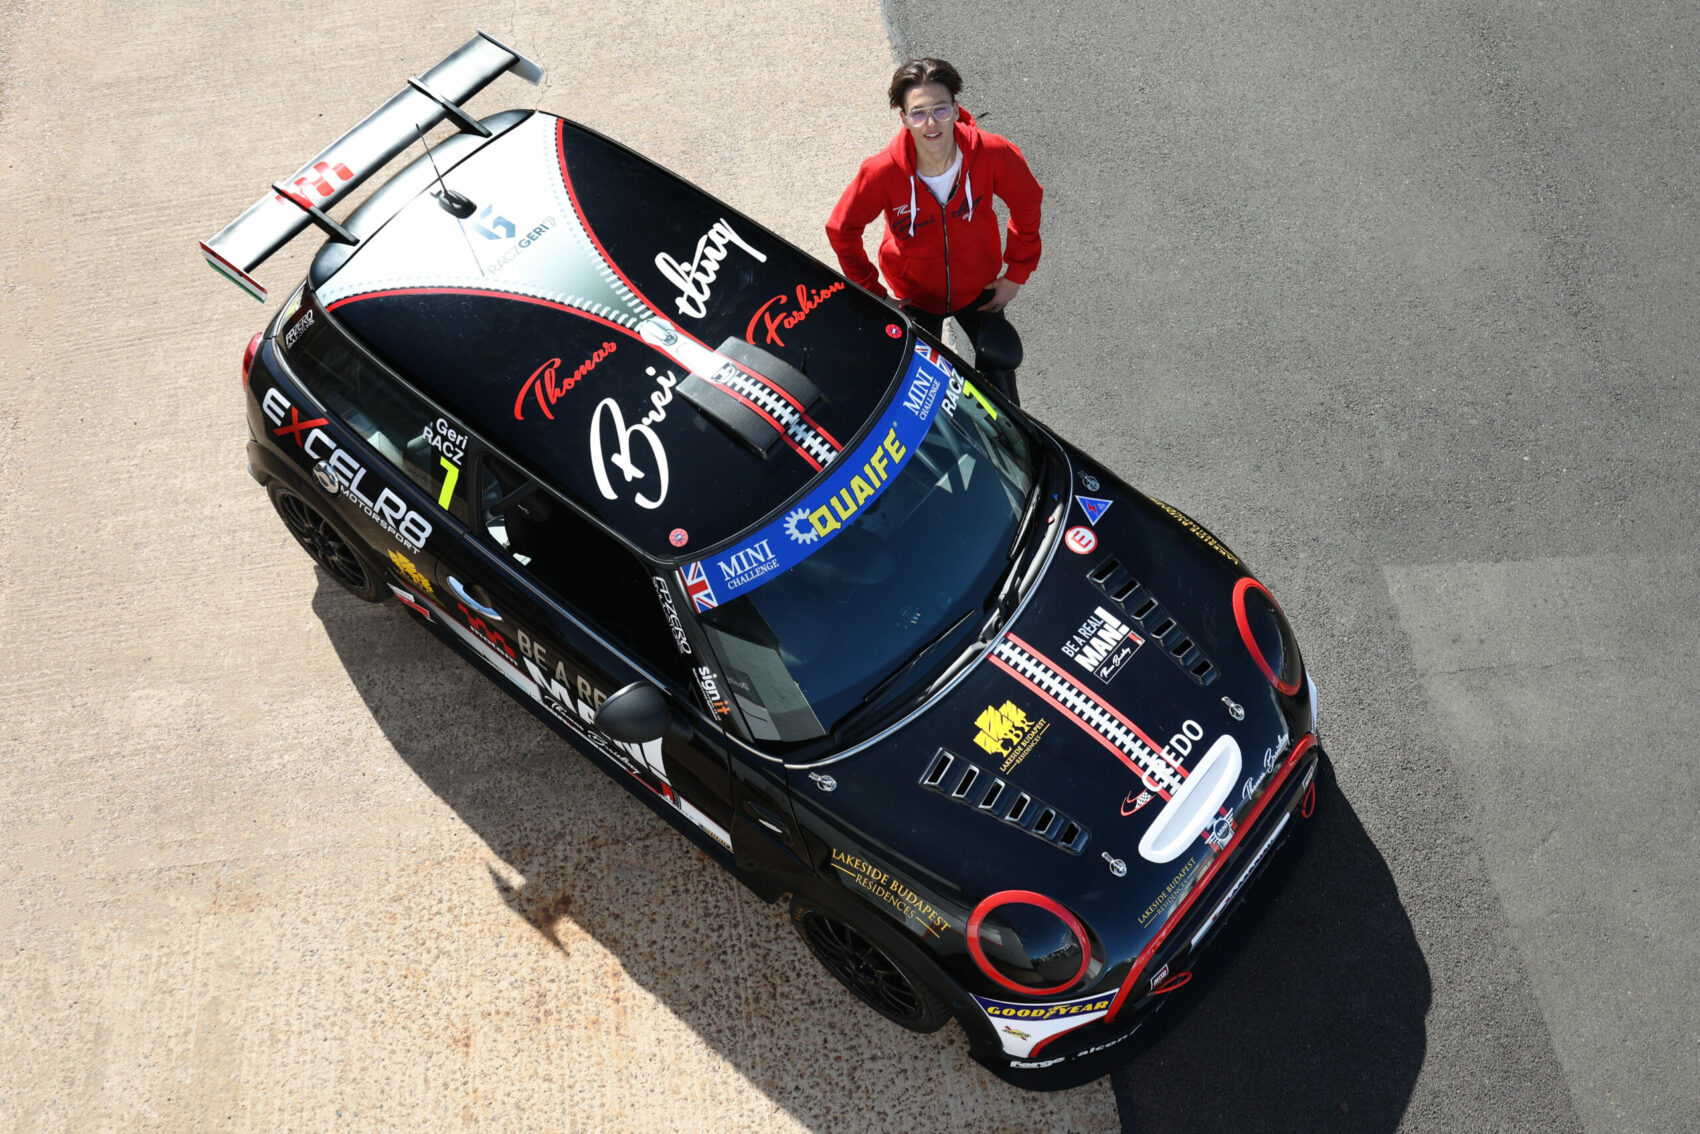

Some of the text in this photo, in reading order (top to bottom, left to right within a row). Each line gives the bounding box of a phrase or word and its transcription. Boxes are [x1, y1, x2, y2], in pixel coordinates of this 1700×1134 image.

[514, 280, 845, 421] Thomas Fashion
[902, 366, 934, 416] MINI
[918, 380, 941, 420] CHALLENGE
[941, 368, 965, 416] RACZ
[422, 426, 465, 465] RACZ
[435, 417, 469, 448] Geri
[262, 387, 433, 549] EXCELR8
[340, 488, 421, 554] MOTORSPORT
[1070, 530, 1092, 548] E
[717, 538, 776, 580] MINI
[727, 558, 779, 590] CHALLENGE
[517, 628, 546, 670] BE
[554, 660, 569, 689] A
[1061, 616, 1105, 657] BE A REAL
[1074, 606, 1129, 673] MAN!
[999, 717, 1046, 773] LAKESIDE BUDAPEST
[1141, 719, 1203, 793] CREDO
[831, 848, 951, 933] LAKESIDE BUDAPEST
[855, 874, 916, 919] RESIDENCES
[1137, 890, 1168, 925] LAKESIDE
[1165, 857, 1196, 892] BUDAPEST
[1157, 879, 1188, 916] RESIDENCES
[987, 999, 1110, 1020] GOODYEAR
